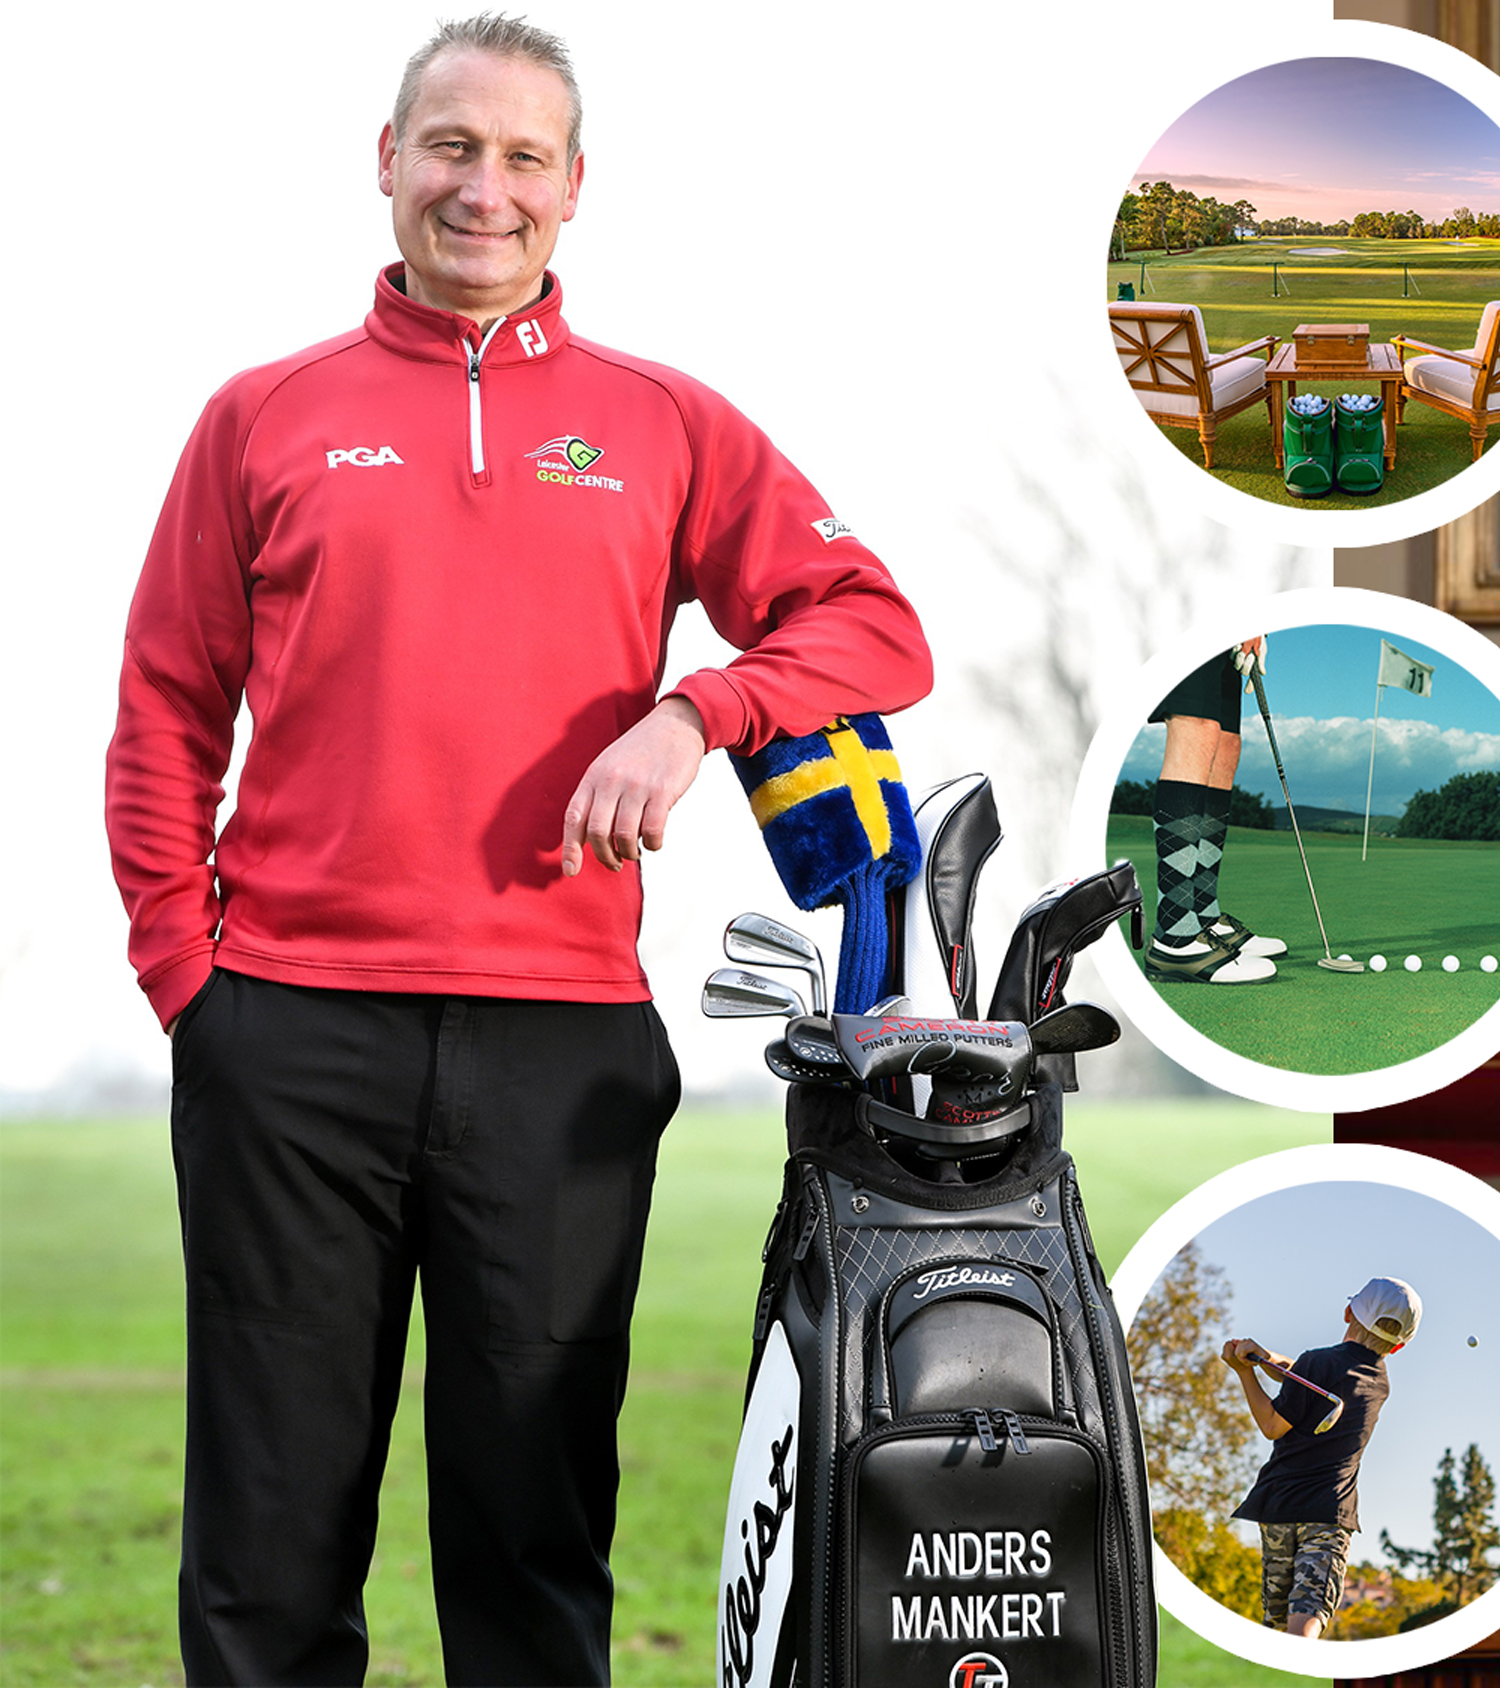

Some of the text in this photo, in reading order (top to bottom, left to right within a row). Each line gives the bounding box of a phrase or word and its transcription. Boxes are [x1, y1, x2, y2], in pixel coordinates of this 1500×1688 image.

[326, 446, 404, 469] PGA
[1409, 667, 1424, 693] 11
[855, 1021, 1010, 1043] CAMERON
[861, 1033, 1013, 1053] FINE MILLED PUTTERS
[913, 1265, 1016, 1299] Titleist
[904, 1529, 1053, 1576] ANDERS
[890, 1591, 1067, 1641] MANKERT
